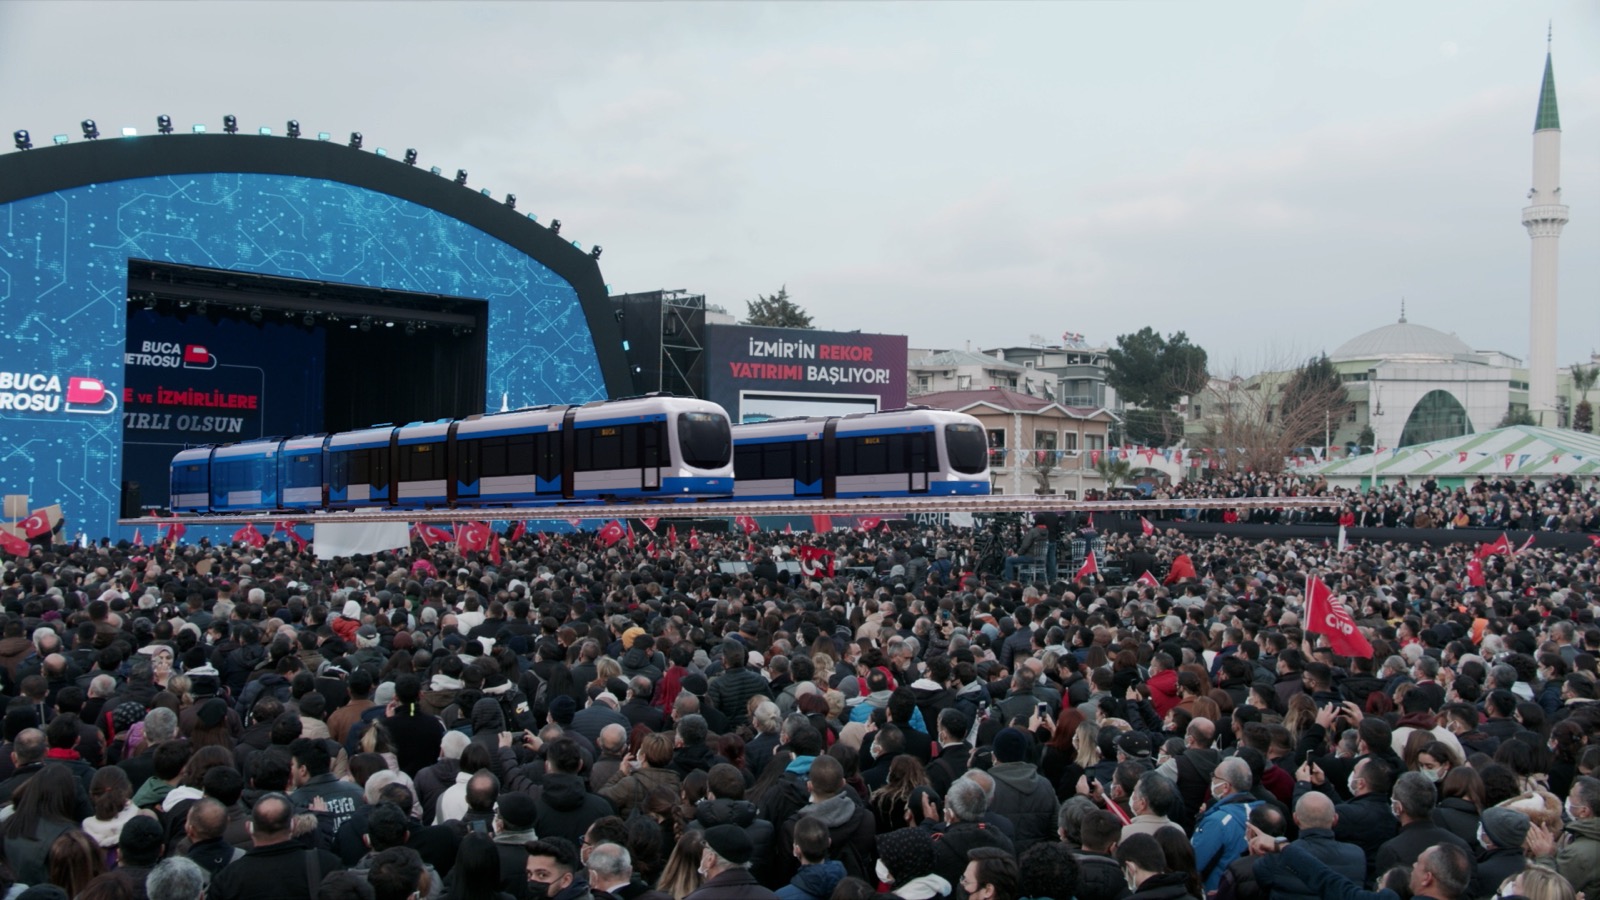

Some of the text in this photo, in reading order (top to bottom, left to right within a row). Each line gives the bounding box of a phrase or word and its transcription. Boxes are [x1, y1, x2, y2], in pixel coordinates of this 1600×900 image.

[141, 340, 181, 355] BUCA
[819, 344, 873, 362] REKOR
[0, 372, 61, 392] BUCA
[729, 362, 890, 385] YATIRIMI BAŞLIYOR!
[157, 385, 257, 409] İZMİRLİLERE
[176, 414, 244, 433] OLSUN
[864, 437, 880, 445] BUCA
[1325, 613, 1353, 636] CHP
